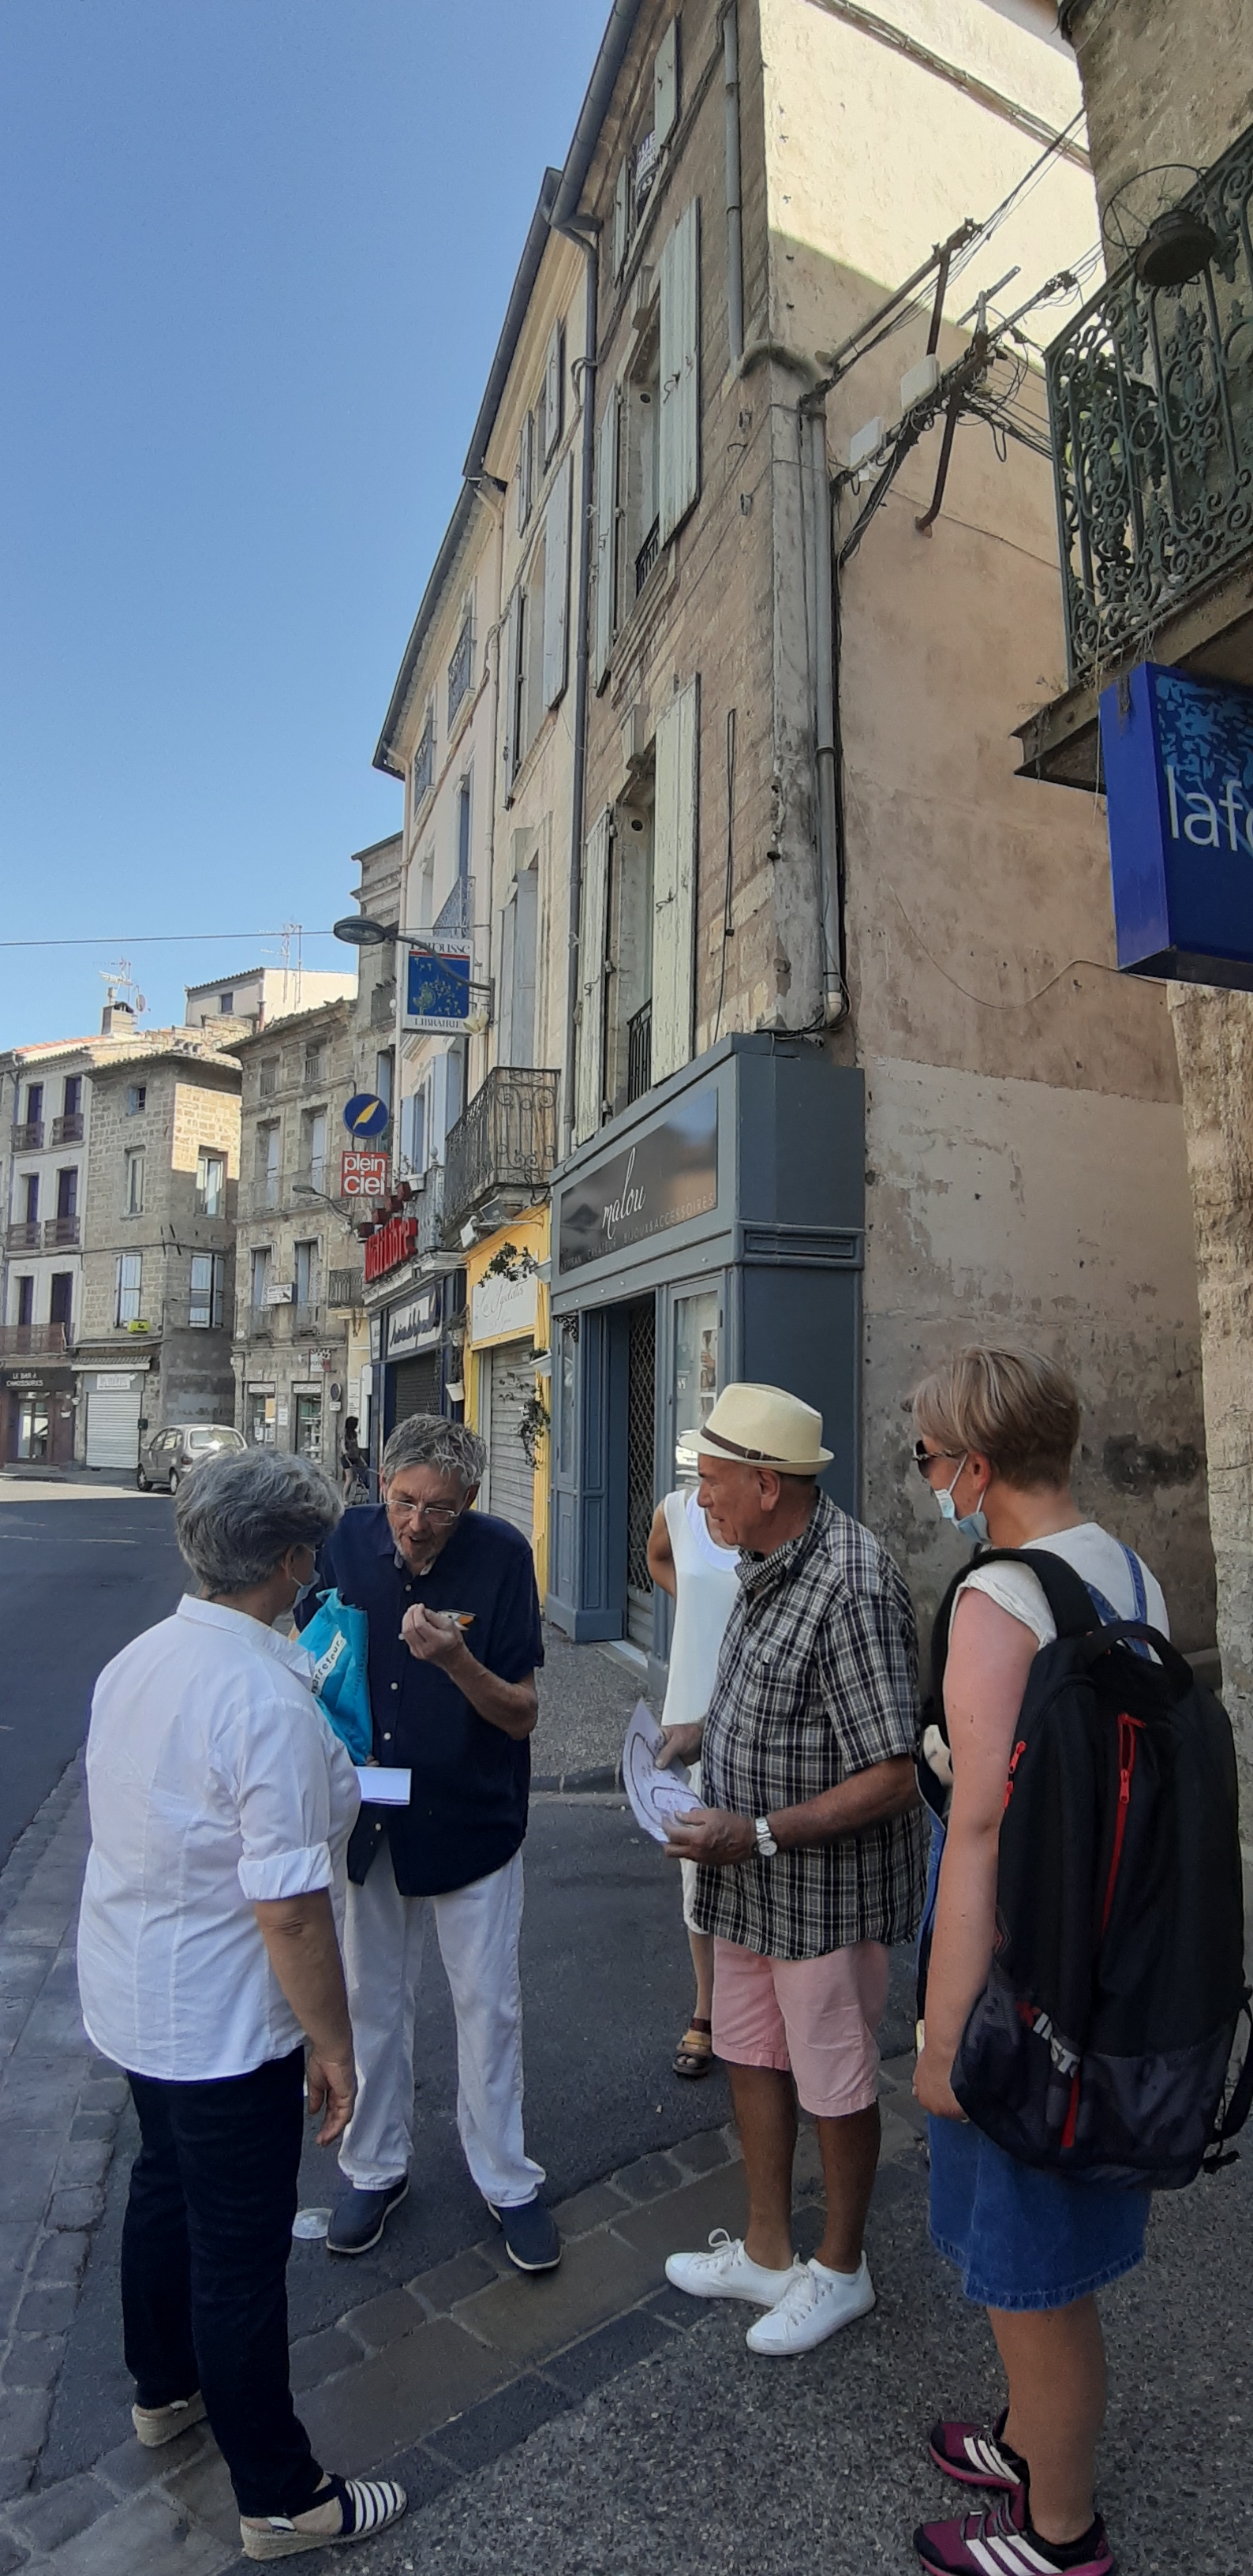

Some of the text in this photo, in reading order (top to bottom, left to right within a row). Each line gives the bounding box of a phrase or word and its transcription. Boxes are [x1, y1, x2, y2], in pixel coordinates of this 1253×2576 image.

[1165, 765, 1253, 852] laf
[343, 1171, 385, 1195] ciel
[344, 1153, 386, 1174] plein
[602, 1146, 646, 1240] malou
